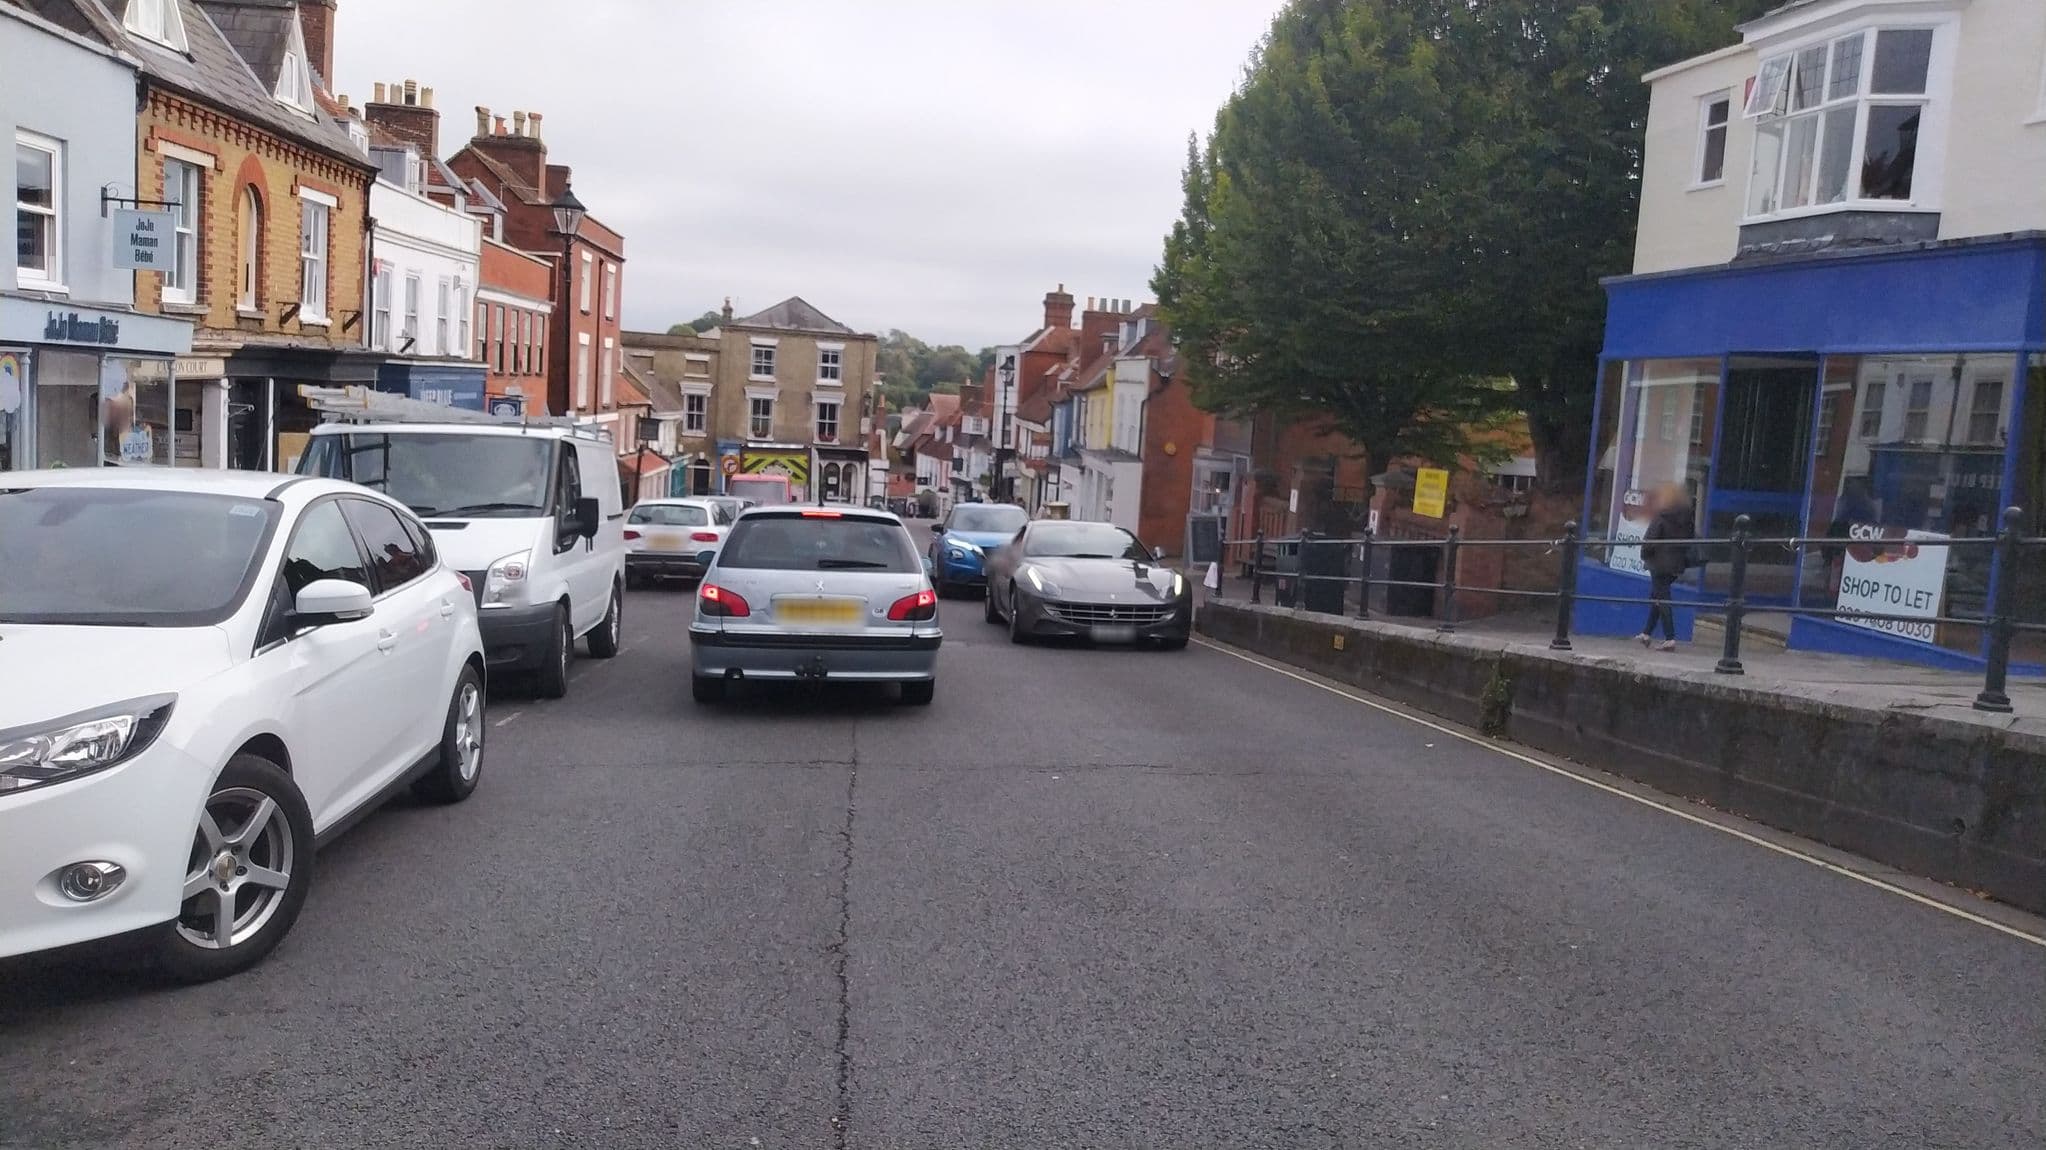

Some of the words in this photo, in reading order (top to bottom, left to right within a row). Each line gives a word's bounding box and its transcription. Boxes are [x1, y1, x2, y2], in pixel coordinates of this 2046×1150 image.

[136, 217, 154, 231] JoJo
[130, 233, 158, 248] Maman
[1848, 523, 1885, 540] GCW
[1841, 575, 1880, 599] SHOP
[1883, 583, 1902, 605] TO
[1904, 588, 1934, 611] LET
[1896, 618, 1932, 639] 0030
